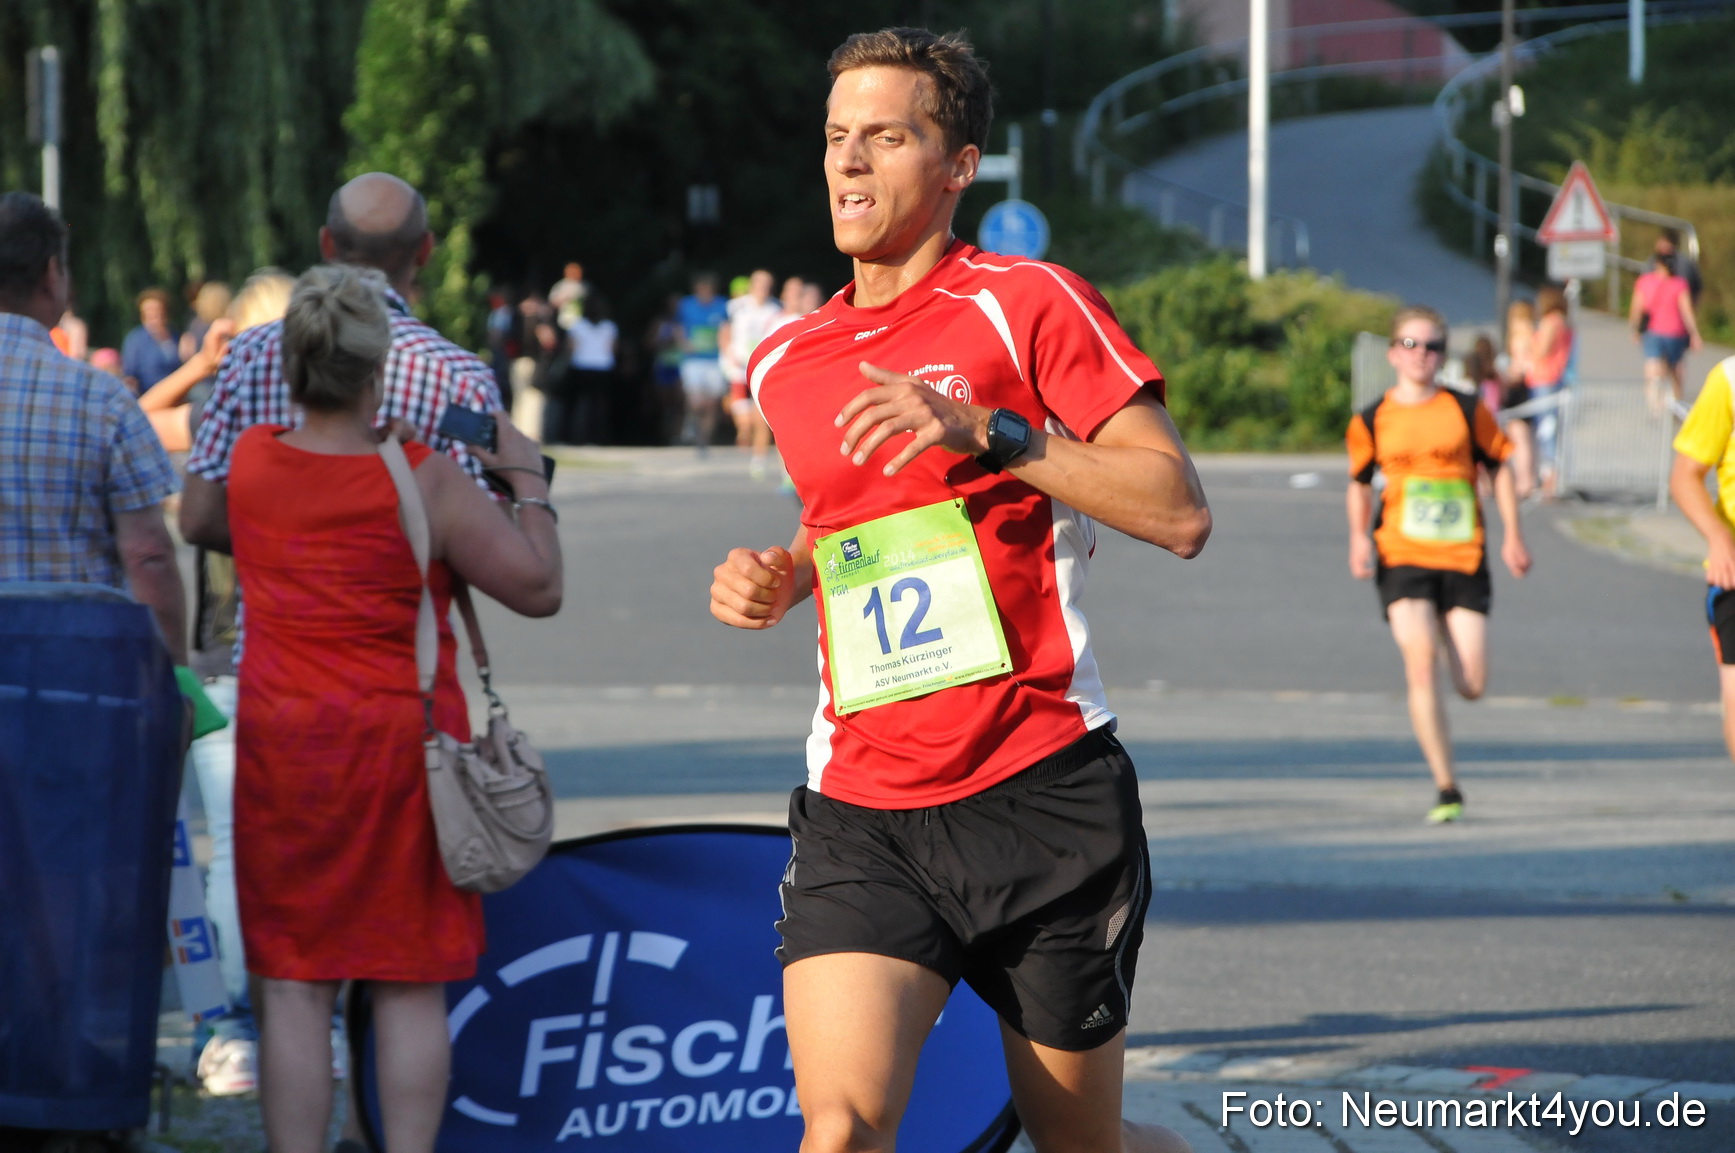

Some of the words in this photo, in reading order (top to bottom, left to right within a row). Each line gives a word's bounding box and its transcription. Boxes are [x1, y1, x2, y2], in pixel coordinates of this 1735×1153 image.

[854, 325, 893, 341] CRAF
[908, 363, 954, 377] Laufteam
[838, 549, 880, 575] firmenlauf
[883, 549, 916, 567] 2014
[863, 577, 944, 655] 12
[869, 661, 901, 675] Thomas
[901, 646, 953, 667] Kürzinger
[875, 677, 890, 688] ASV
[892, 667, 933, 684] Neumarkt
[935, 661, 953, 673] e.V.
[519, 994, 795, 1097] Fisch
